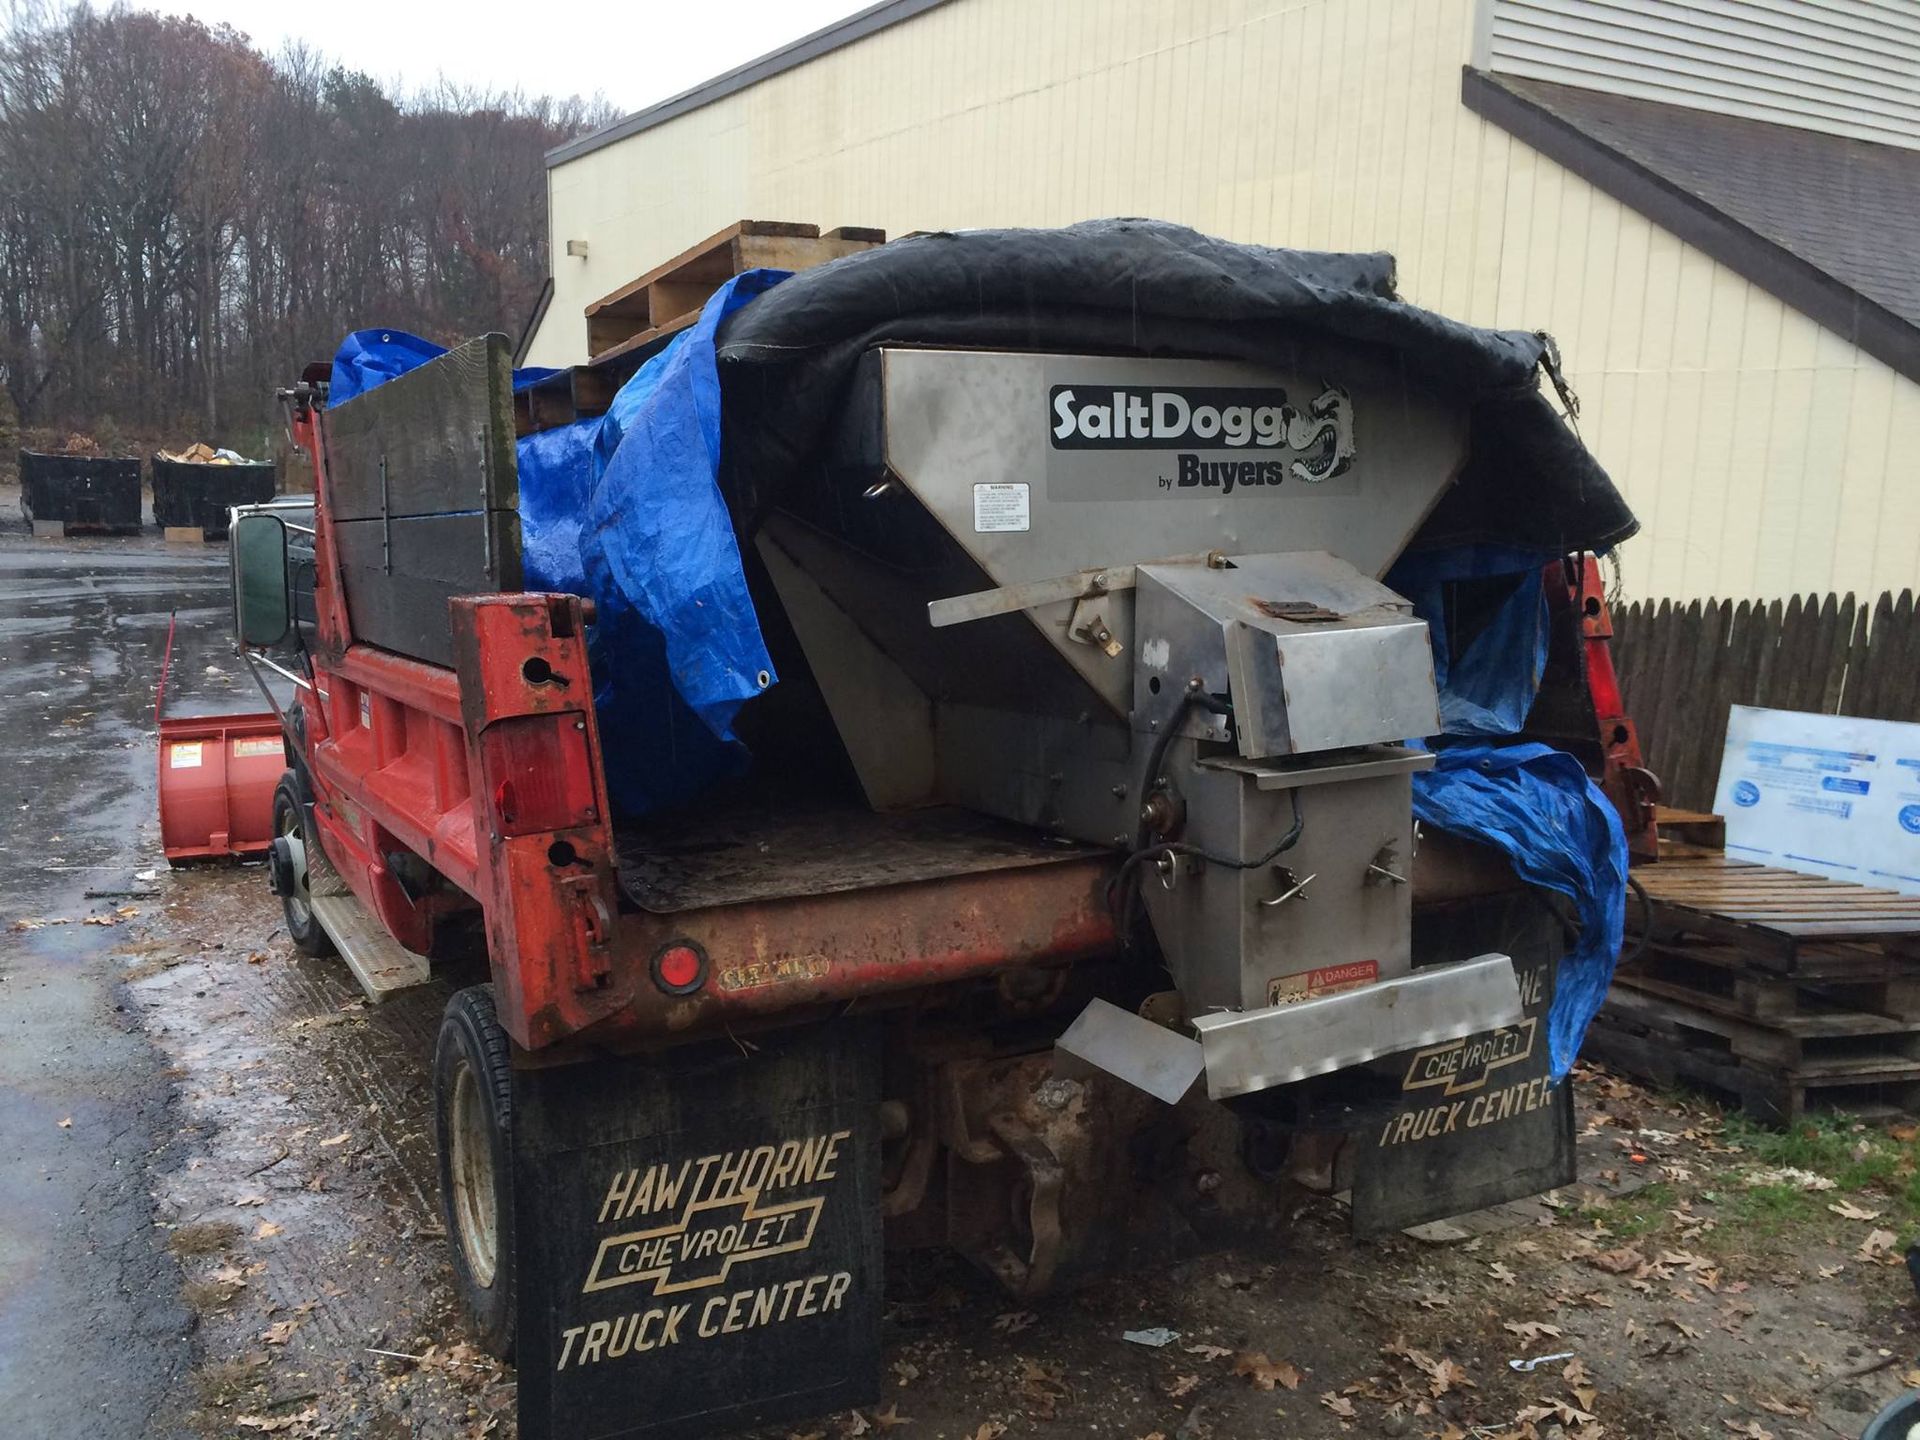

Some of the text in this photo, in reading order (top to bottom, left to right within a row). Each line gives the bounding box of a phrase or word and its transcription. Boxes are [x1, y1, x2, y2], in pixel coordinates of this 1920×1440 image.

[1053, 389, 1283, 447] SaltDogg
[1158, 453, 1283, 494] by Buyers
[1325, 964, 1375, 983] DANGER
[1424, 1032, 1520, 1079] CHEVROLET
[1379, 1075, 1552, 1147] TRUCK CENTER
[597, 1130, 851, 1223] HAWTHORNE
[617, 1213, 797, 1273] CHEVROLET
[556, 1271, 852, 1372] TRUCK CENTER
